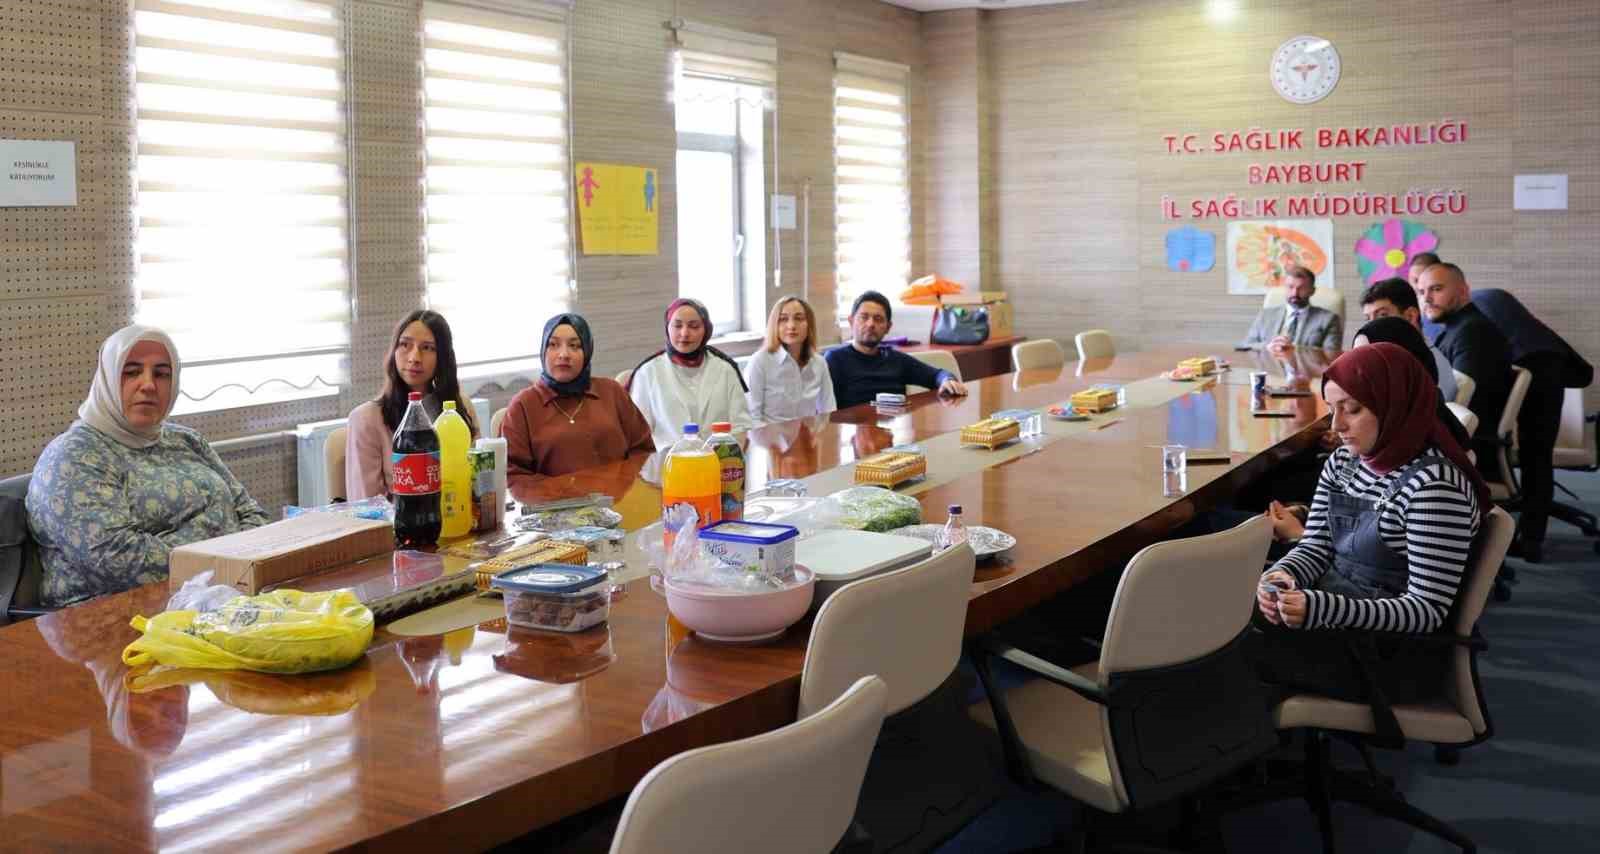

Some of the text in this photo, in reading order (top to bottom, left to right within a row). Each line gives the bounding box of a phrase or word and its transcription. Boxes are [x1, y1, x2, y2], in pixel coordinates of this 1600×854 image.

[1164, 119, 1467, 153] T.C. SAĞLIK BAKANLIĞI
[1249, 162, 1367, 184] BAYBURT
[1163, 190, 1467, 218] İL SAĞLIK MÜDÜRLÜĞÜ
